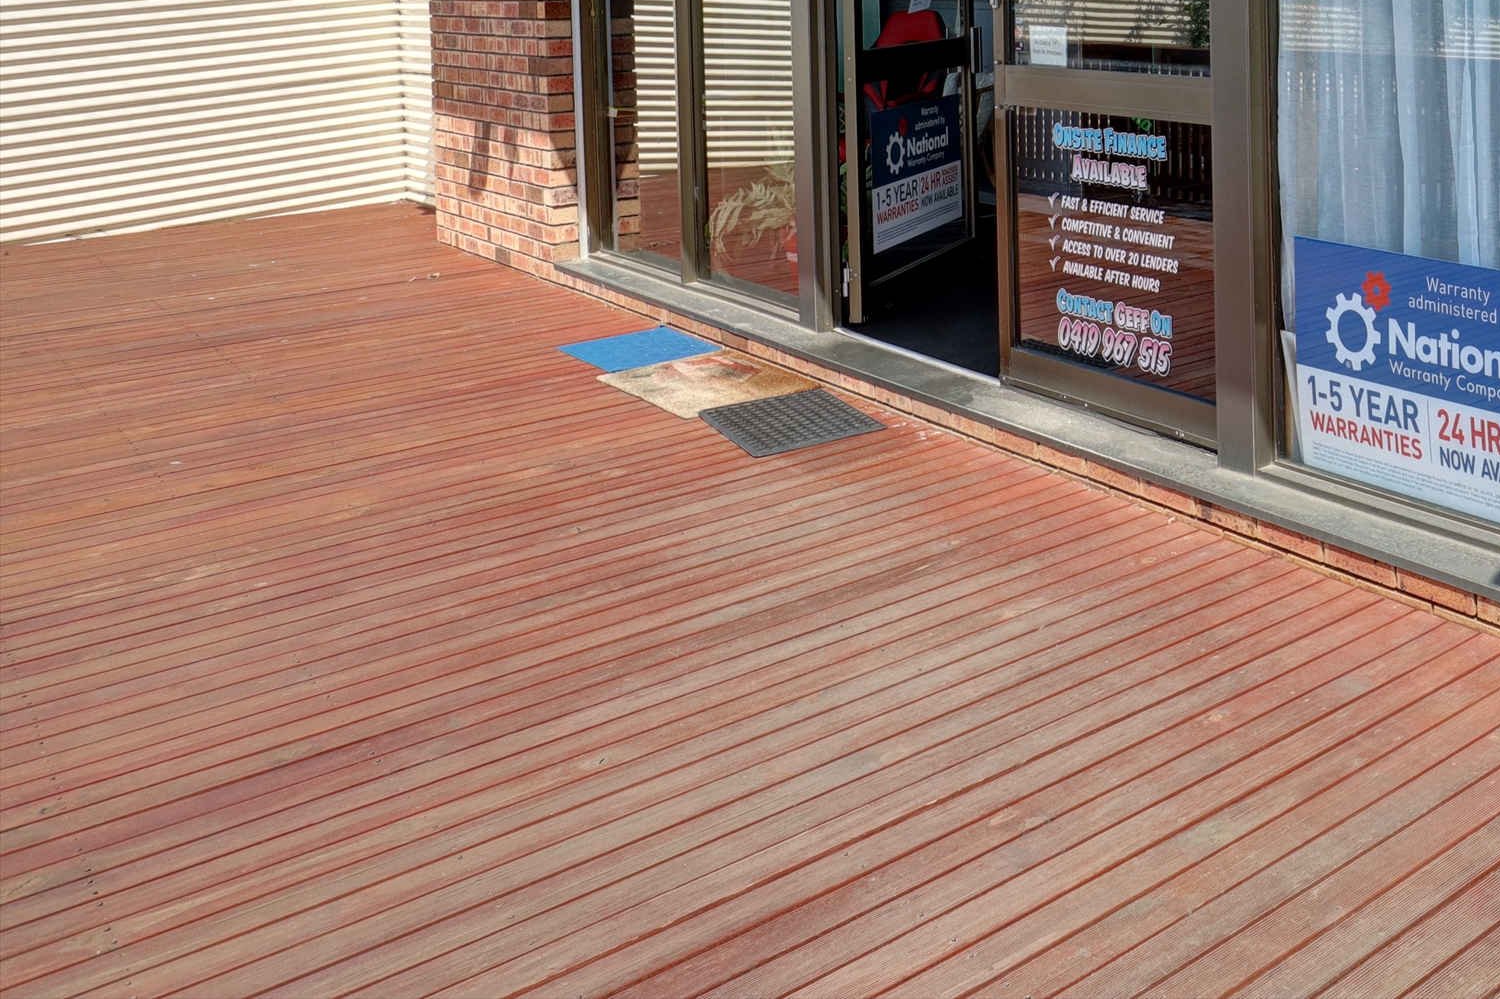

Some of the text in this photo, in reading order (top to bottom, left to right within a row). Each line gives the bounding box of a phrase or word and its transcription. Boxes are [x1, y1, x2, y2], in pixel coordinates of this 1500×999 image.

[914, 116, 946, 131] administered by
[921, 105, 939, 116] Warranty
[906, 126, 949, 158] National
[1053, 122, 1103, 153] ONSITE
[1103, 126, 1168, 161] FINANCE
[907, 150, 945, 168] Warranty Company
[1072, 153, 1148, 191] AVAILABLE
[876, 179, 918, 211] 1-5 YEAR
[920, 171, 941, 195] 24 HR
[942, 172, 958, 188] ASSIST
[876, 198, 919, 225] WARRANTIES
[921, 184, 959, 209] NOW AVAILABLE
[1061, 195, 1165, 225] FAST & EFFICIENT SERVICE
[1061, 216, 1175, 250] COMPETITIVE & CONVENIENT
[1062, 238, 1179, 275] ACCESS TO OVER 20 LENDERS
[1063, 259, 1161, 293] AVAILABLE AFTER HOURS
[1425, 275, 1491, 305] Warranty
[1056, 287, 1173, 338] CONTACT GEFF ON
[1408, 294, 1498, 325] administered
[1057, 315, 1173, 377] 0419 967 515
[1388, 357, 1452, 392] Warranty
[1306, 374, 1421, 434] 1-5 YEAR
[1309, 409, 1423, 461] WARRANTIES
[1436, 408, 1466, 446] 24
[1438, 445, 1478, 476] NOW
